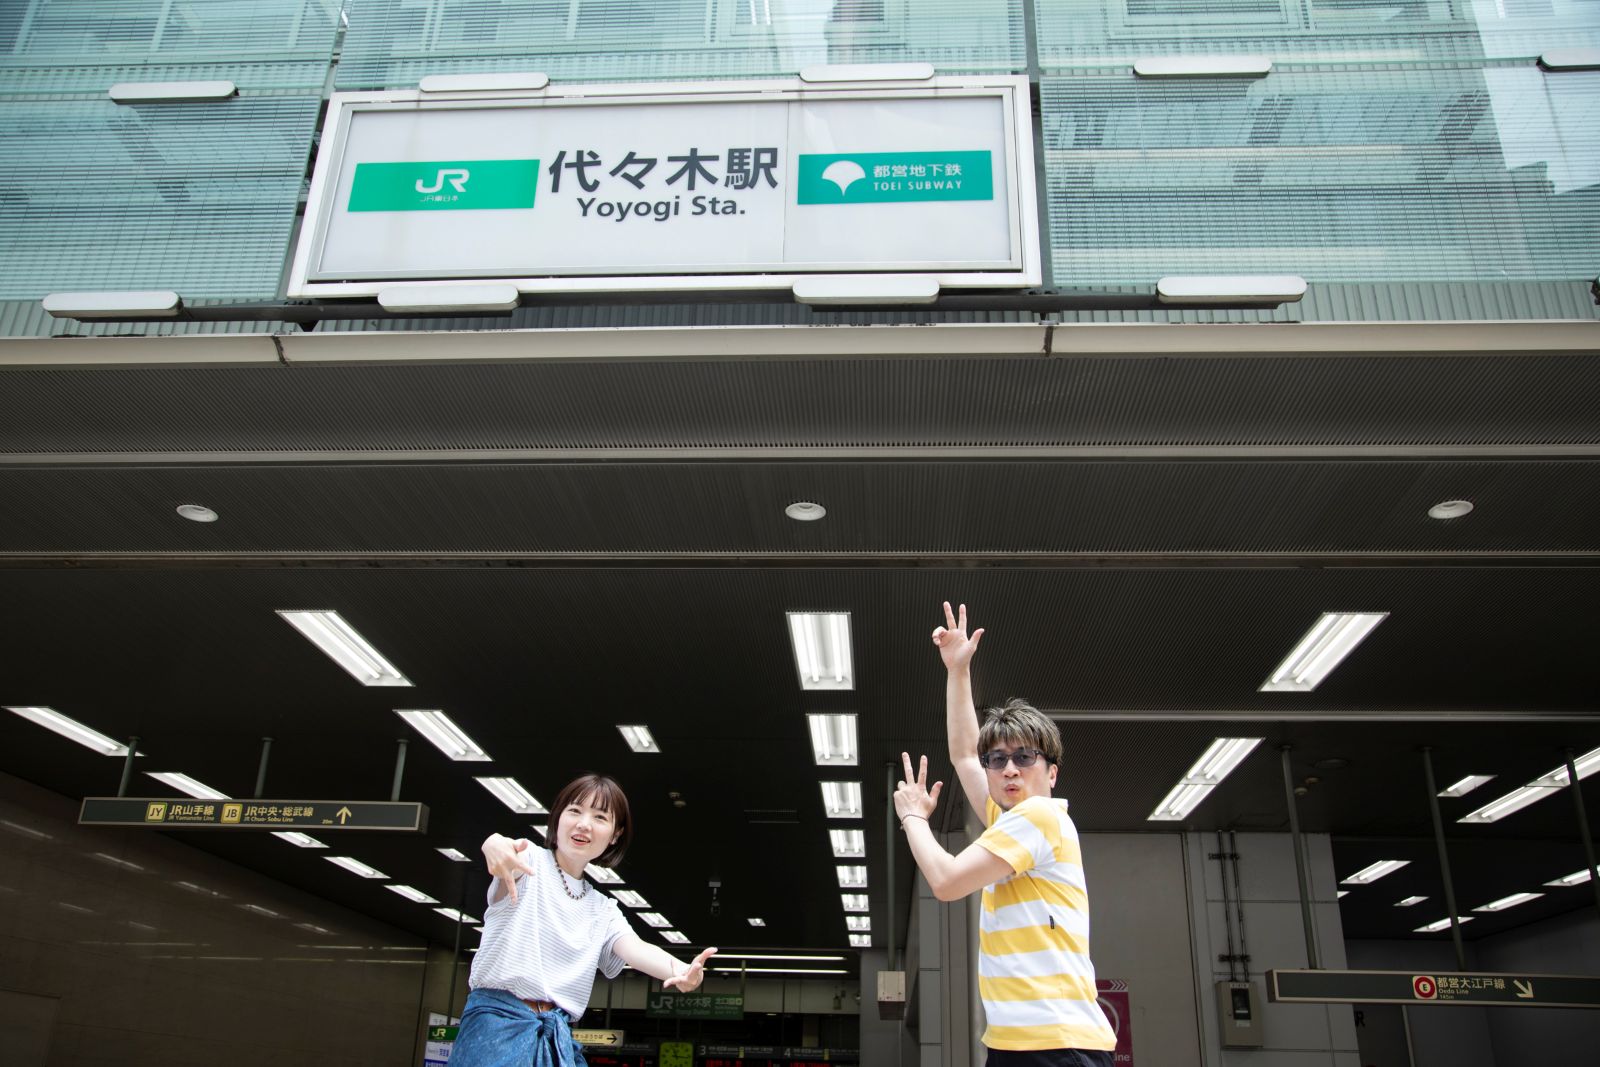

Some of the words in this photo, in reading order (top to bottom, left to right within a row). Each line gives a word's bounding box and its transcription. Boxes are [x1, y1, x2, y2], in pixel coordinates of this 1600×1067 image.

[548, 147, 779, 193] 代々木駅
[873, 163, 962, 178] 都営地下鉄
[415, 169, 470, 193] JR
[873, 182, 902, 191] TOEI
[908, 180, 962, 190] SUBWAY
[577, 196, 681, 222] Yoyogi
[691, 196, 746, 216] Sta.
[150, 807, 163, 817] JY
[169, 805, 215, 816] JR山手線
[225, 809, 237, 818] JB
[1437, 977, 1505, 989] 都営大江戸線
[651, 996, 674, 1009] JR
[432, 1028, 446, 1037] JR
[1115, 1053, 1130, 1062] ine
